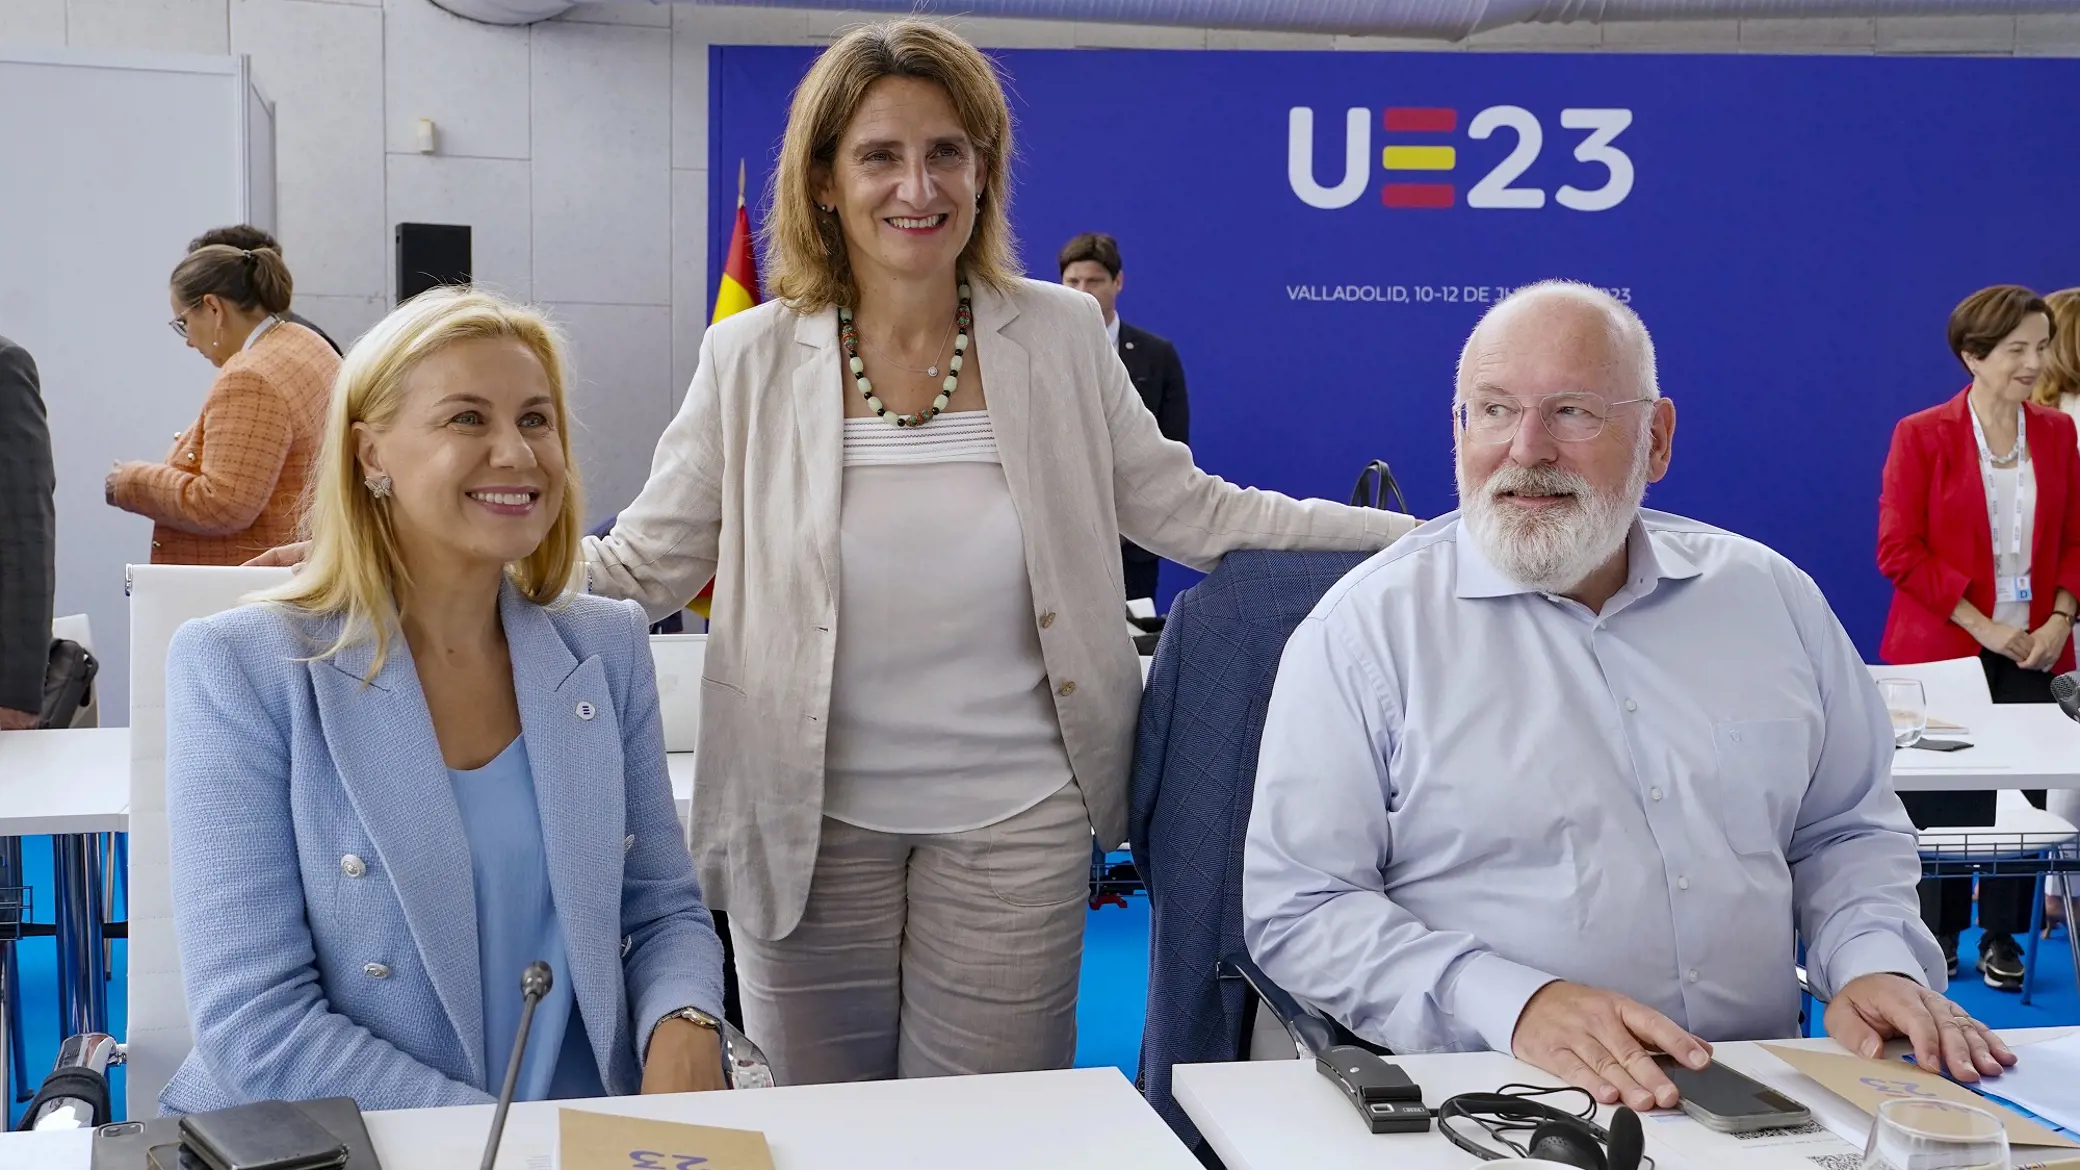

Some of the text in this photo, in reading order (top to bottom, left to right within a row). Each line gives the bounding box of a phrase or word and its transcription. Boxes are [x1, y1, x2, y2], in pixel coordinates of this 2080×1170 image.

[1286, 285, 1410, 304] VALLADOLID,
[1414, 286, 1459, 303] 10-12
[1463, 286, 1490, 303] DE
